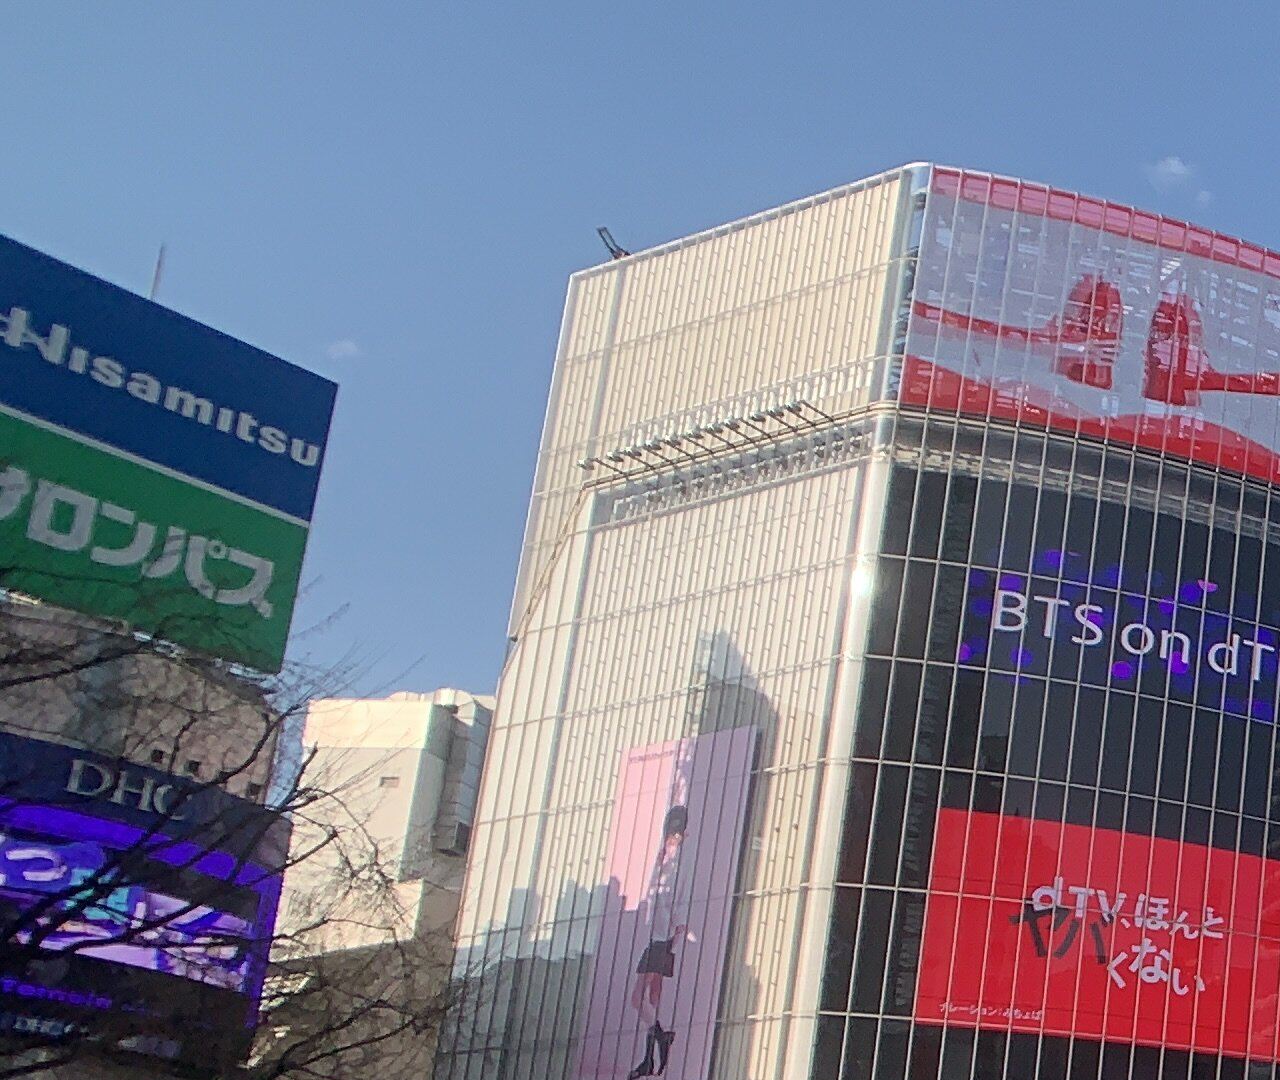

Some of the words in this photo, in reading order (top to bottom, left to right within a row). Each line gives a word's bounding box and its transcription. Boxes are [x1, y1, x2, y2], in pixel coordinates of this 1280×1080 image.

[0, 306, 320, 468] Hisamitsu
[992, 589, 1105, 647] BTS
[1120, 621, 1190, 664] on
